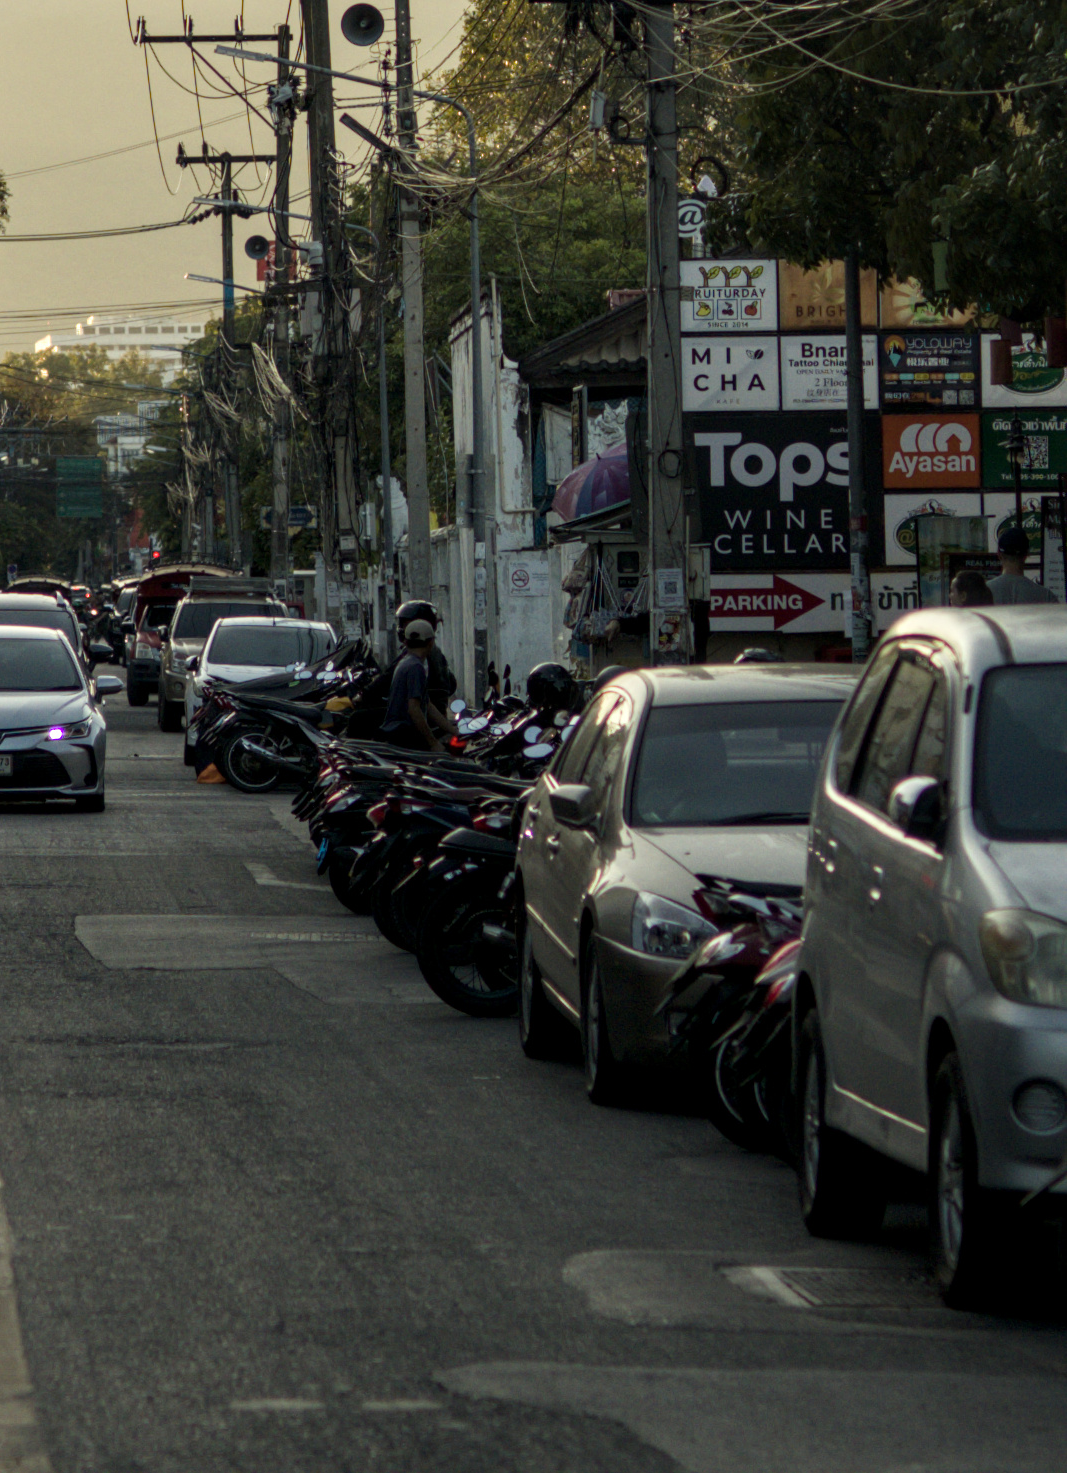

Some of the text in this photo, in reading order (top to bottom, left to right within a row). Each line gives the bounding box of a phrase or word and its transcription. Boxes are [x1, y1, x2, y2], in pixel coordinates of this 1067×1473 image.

[694, 288, 766, 299] RUITURDAY
[796, 305, 846, 318] BRIGH
[788, 359, 819, 367] Tattoo
[693, 373, 766, 392] CHA
[815, 378, 820, 387] 2
[694, 432, 849, 502] Tops
[888, 451, 976, 479] Ayasan
[724, 508, 834, 530] WINE
[714, 532, 848, 554] CELLAR
[710, 594, 803, 611] PARKING
